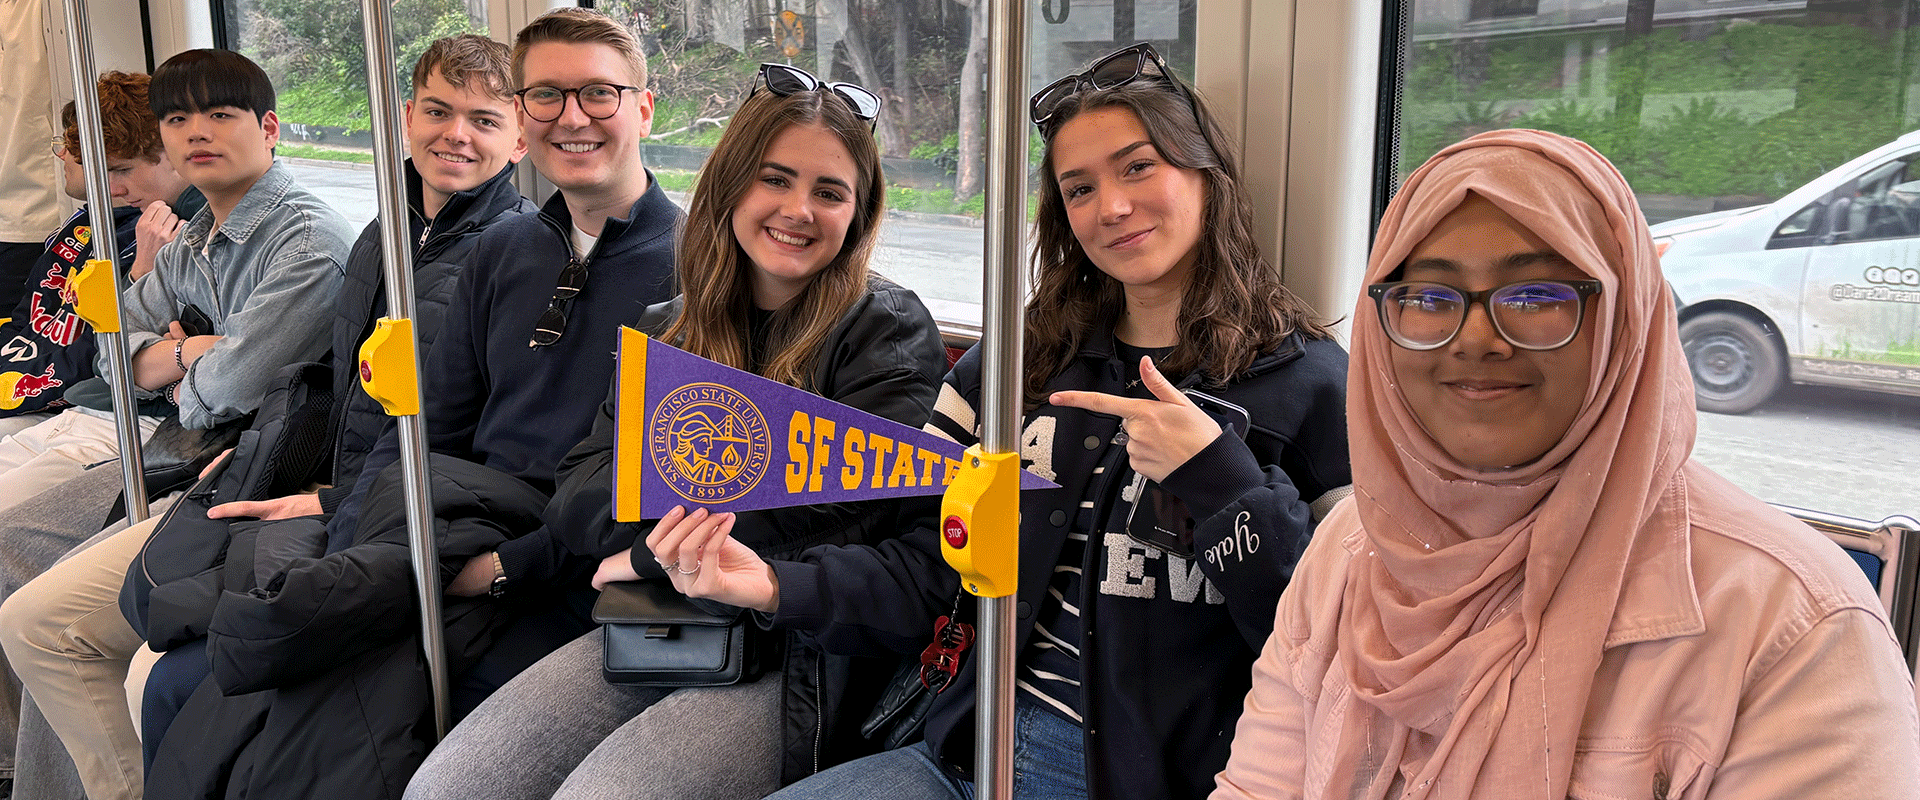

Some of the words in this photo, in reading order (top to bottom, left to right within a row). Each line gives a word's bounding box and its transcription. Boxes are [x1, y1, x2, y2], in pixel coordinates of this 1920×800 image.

[655, 389, 699, 453] FRANCISCO
[701, 388, 744, 411] STATE
[659, 456, 680, 483] SAN
[736, 407, 766, 489] UNIVERSITY
[785, 410, 836, 494] SF
[688, 485, 726, 498] 1899
[947, 528, 962, 538] STOP
[1204, 510, 1260, 572] Yale
